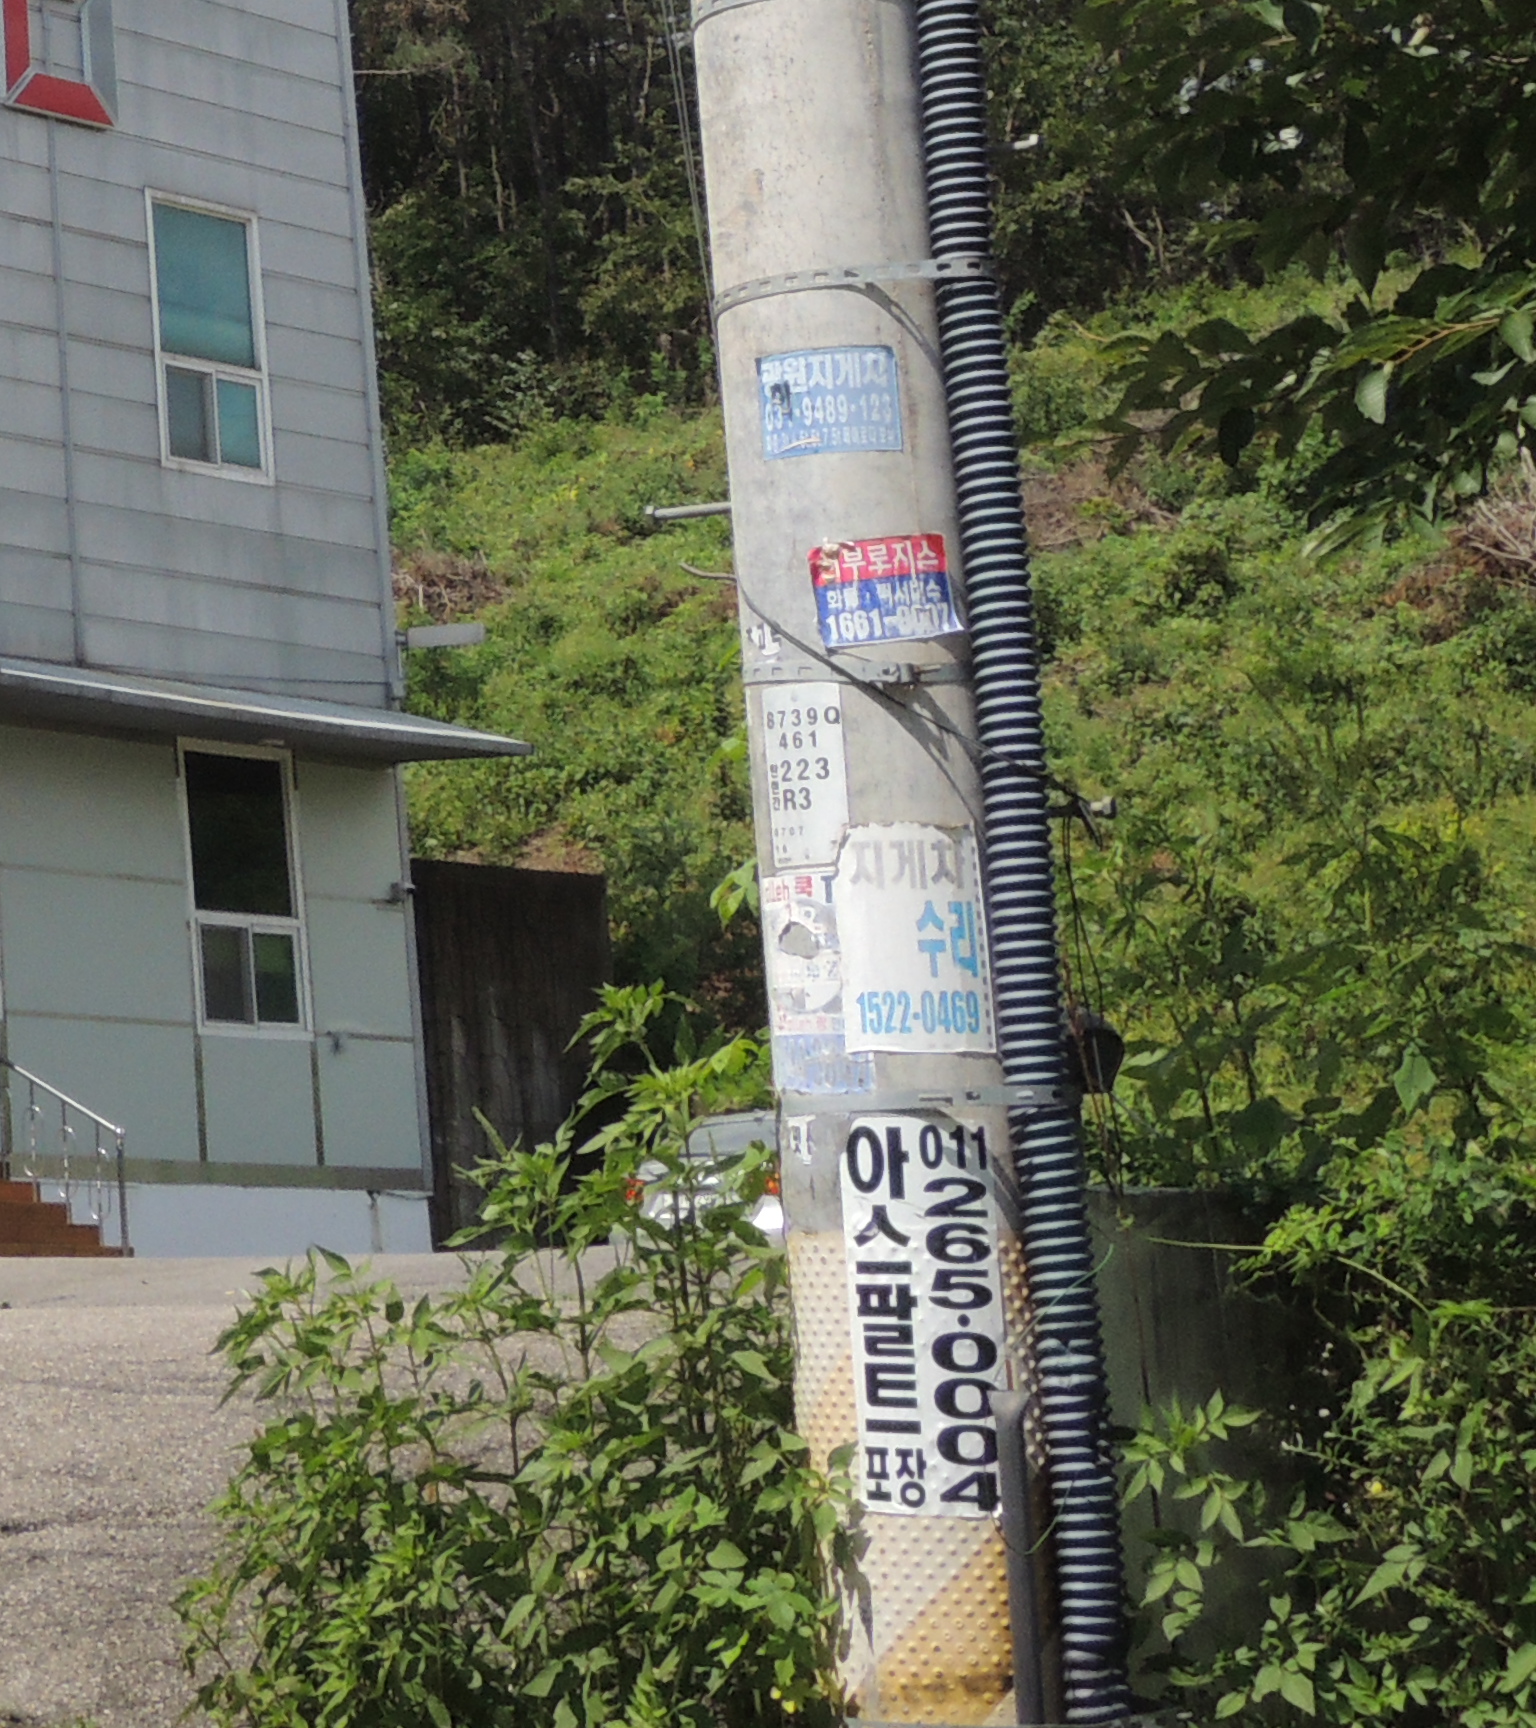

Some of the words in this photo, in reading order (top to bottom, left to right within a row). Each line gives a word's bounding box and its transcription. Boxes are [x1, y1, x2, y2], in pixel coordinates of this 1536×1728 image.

[779, 730, 817, 749] 461
[780, 757, 830, 782] 223
[783, 787, 812, 811] R3
[849, 838, 967, 890] 지게차
[916, 899, 979, 979] 수리
[918, 1124, 988, 1170] 011
[845, 1125, 922, 1436] 아스팔트
